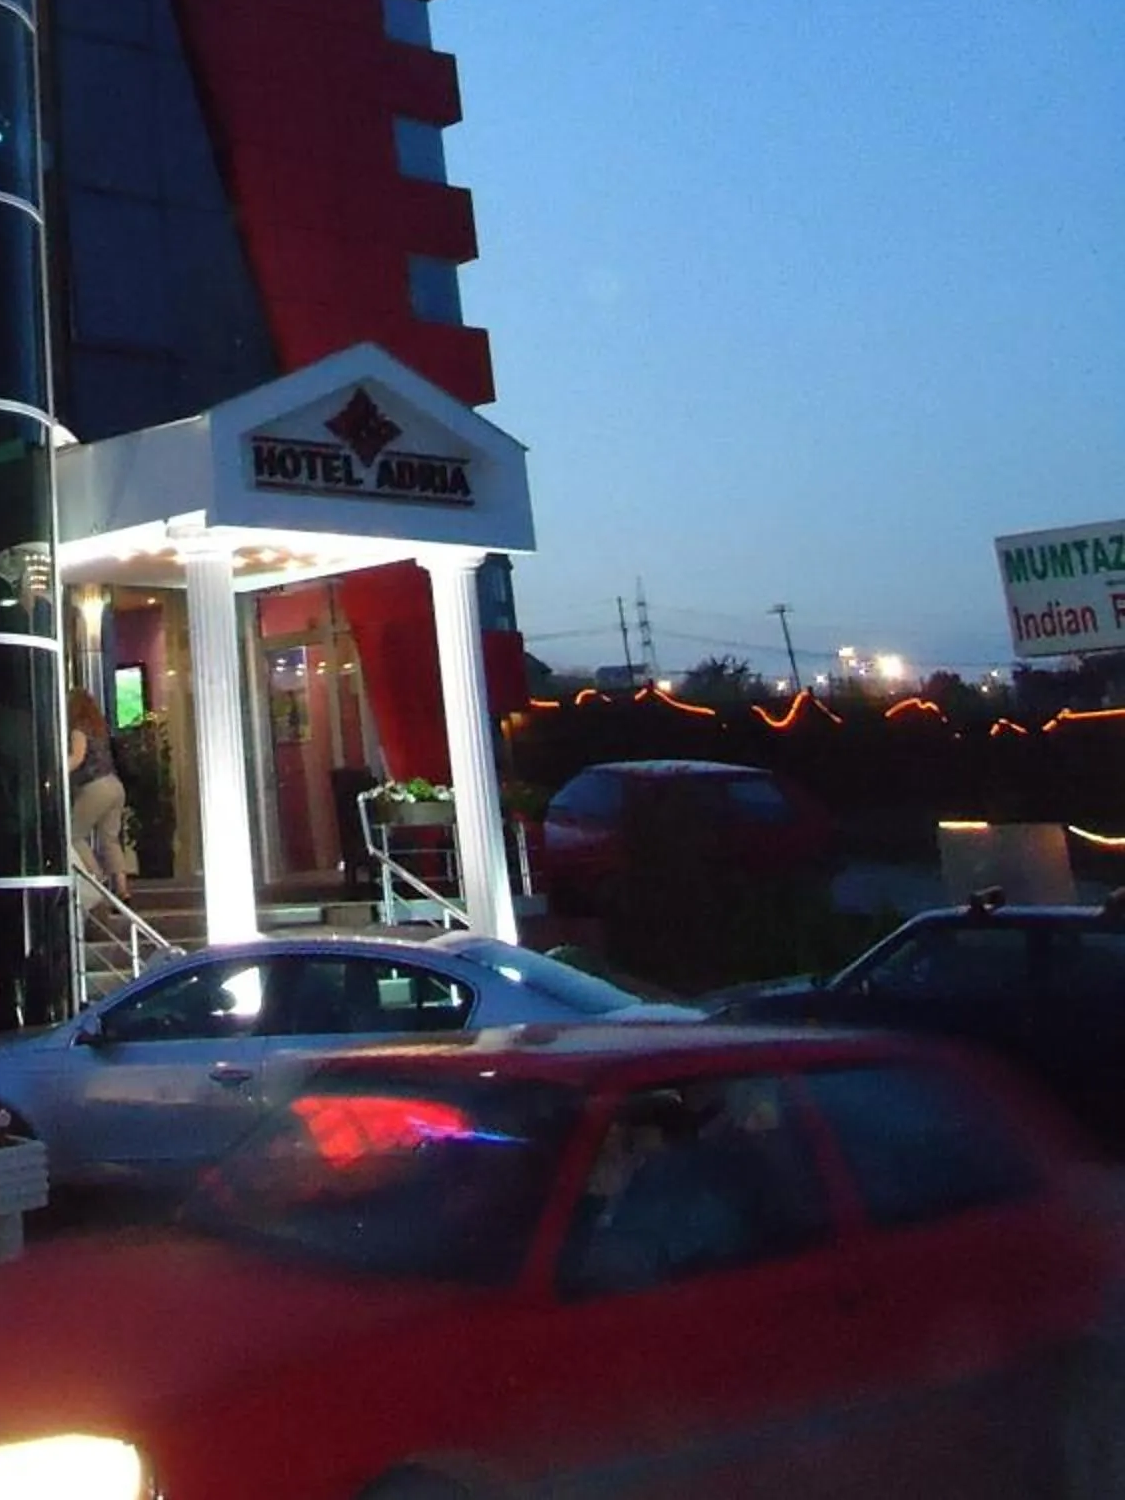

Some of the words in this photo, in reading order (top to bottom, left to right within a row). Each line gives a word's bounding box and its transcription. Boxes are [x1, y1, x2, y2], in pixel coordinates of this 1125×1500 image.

[252, 446, 364, 487] HOTEL
[376, 458, 472, 498] ADRIA
[1004, 533, 1125, 584] MUMTAZ
[1012, 599, 1099, 642] Indian
